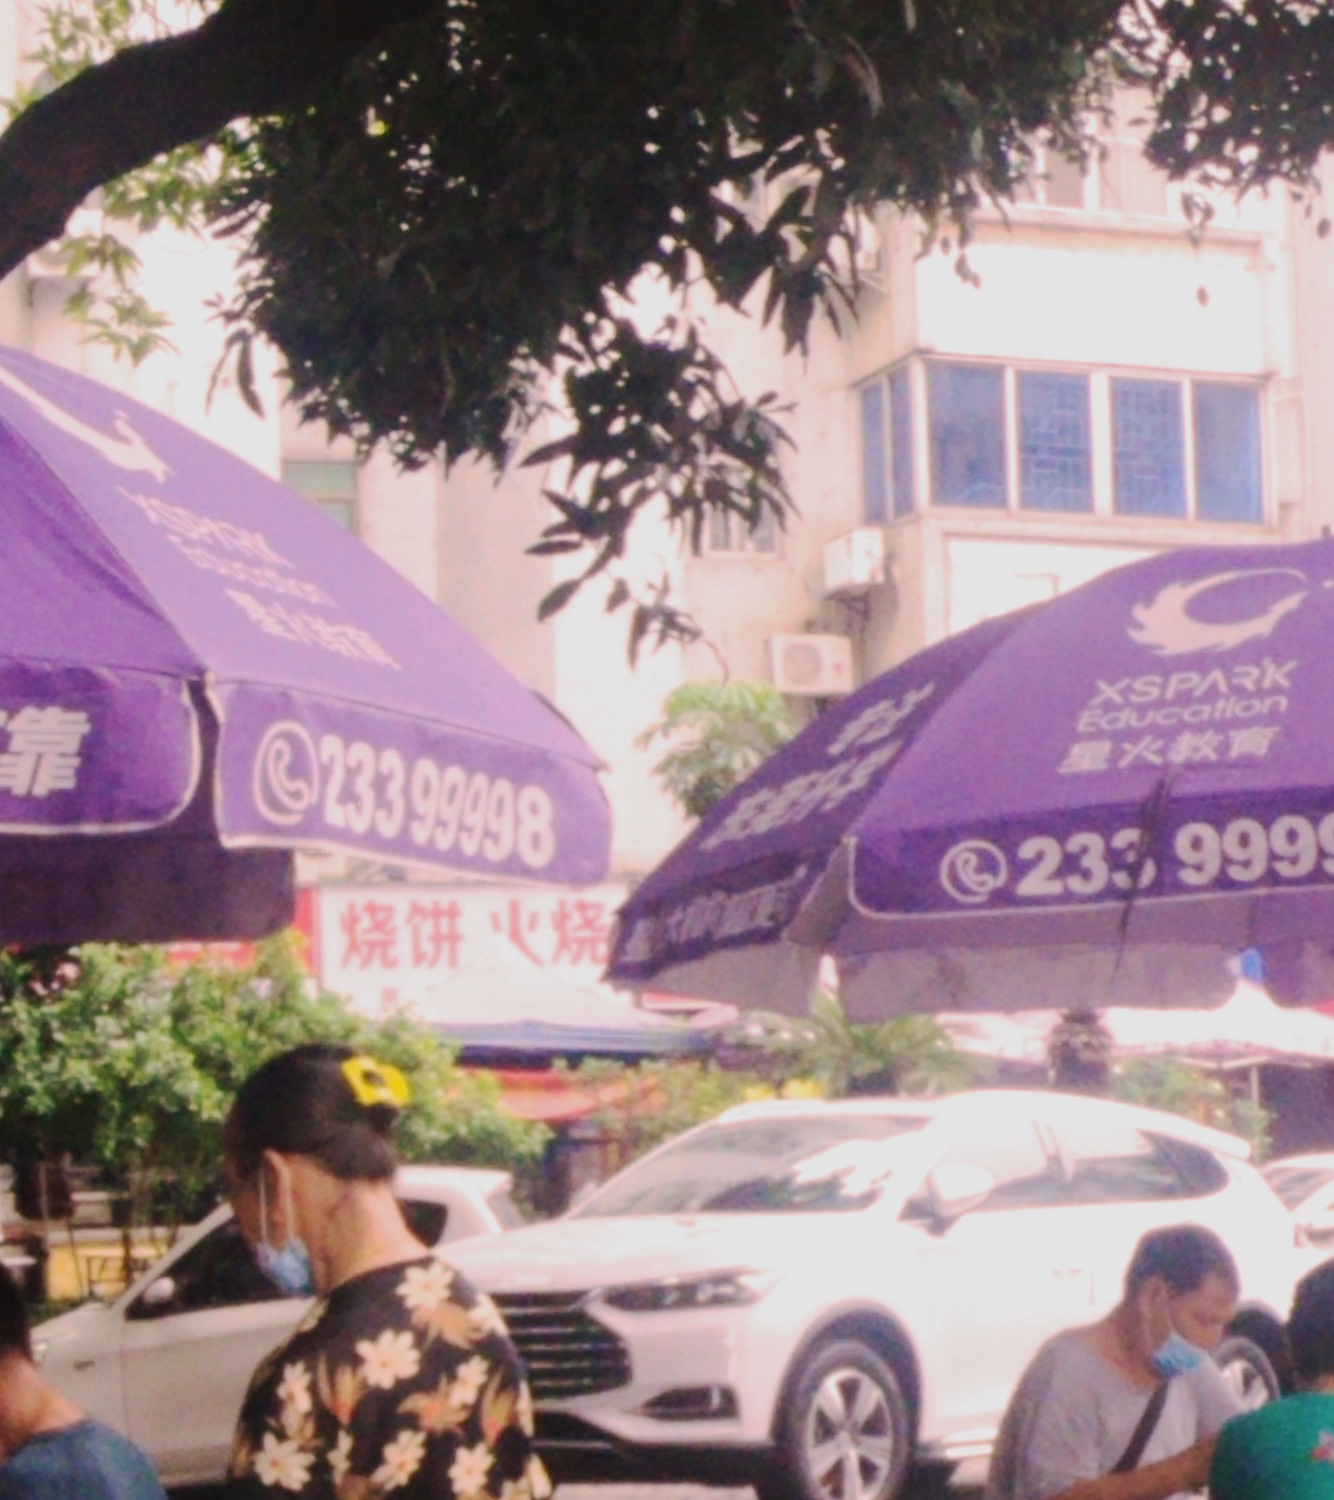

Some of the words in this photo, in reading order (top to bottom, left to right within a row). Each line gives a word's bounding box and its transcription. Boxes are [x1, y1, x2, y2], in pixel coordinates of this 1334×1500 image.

[1088, 658, 1300, 708] XSPARK
[1076, 695, 1290, 733] Education
[339, 898, 463, 970] 烧饼
[488, 898, 609, 968] 火烧
